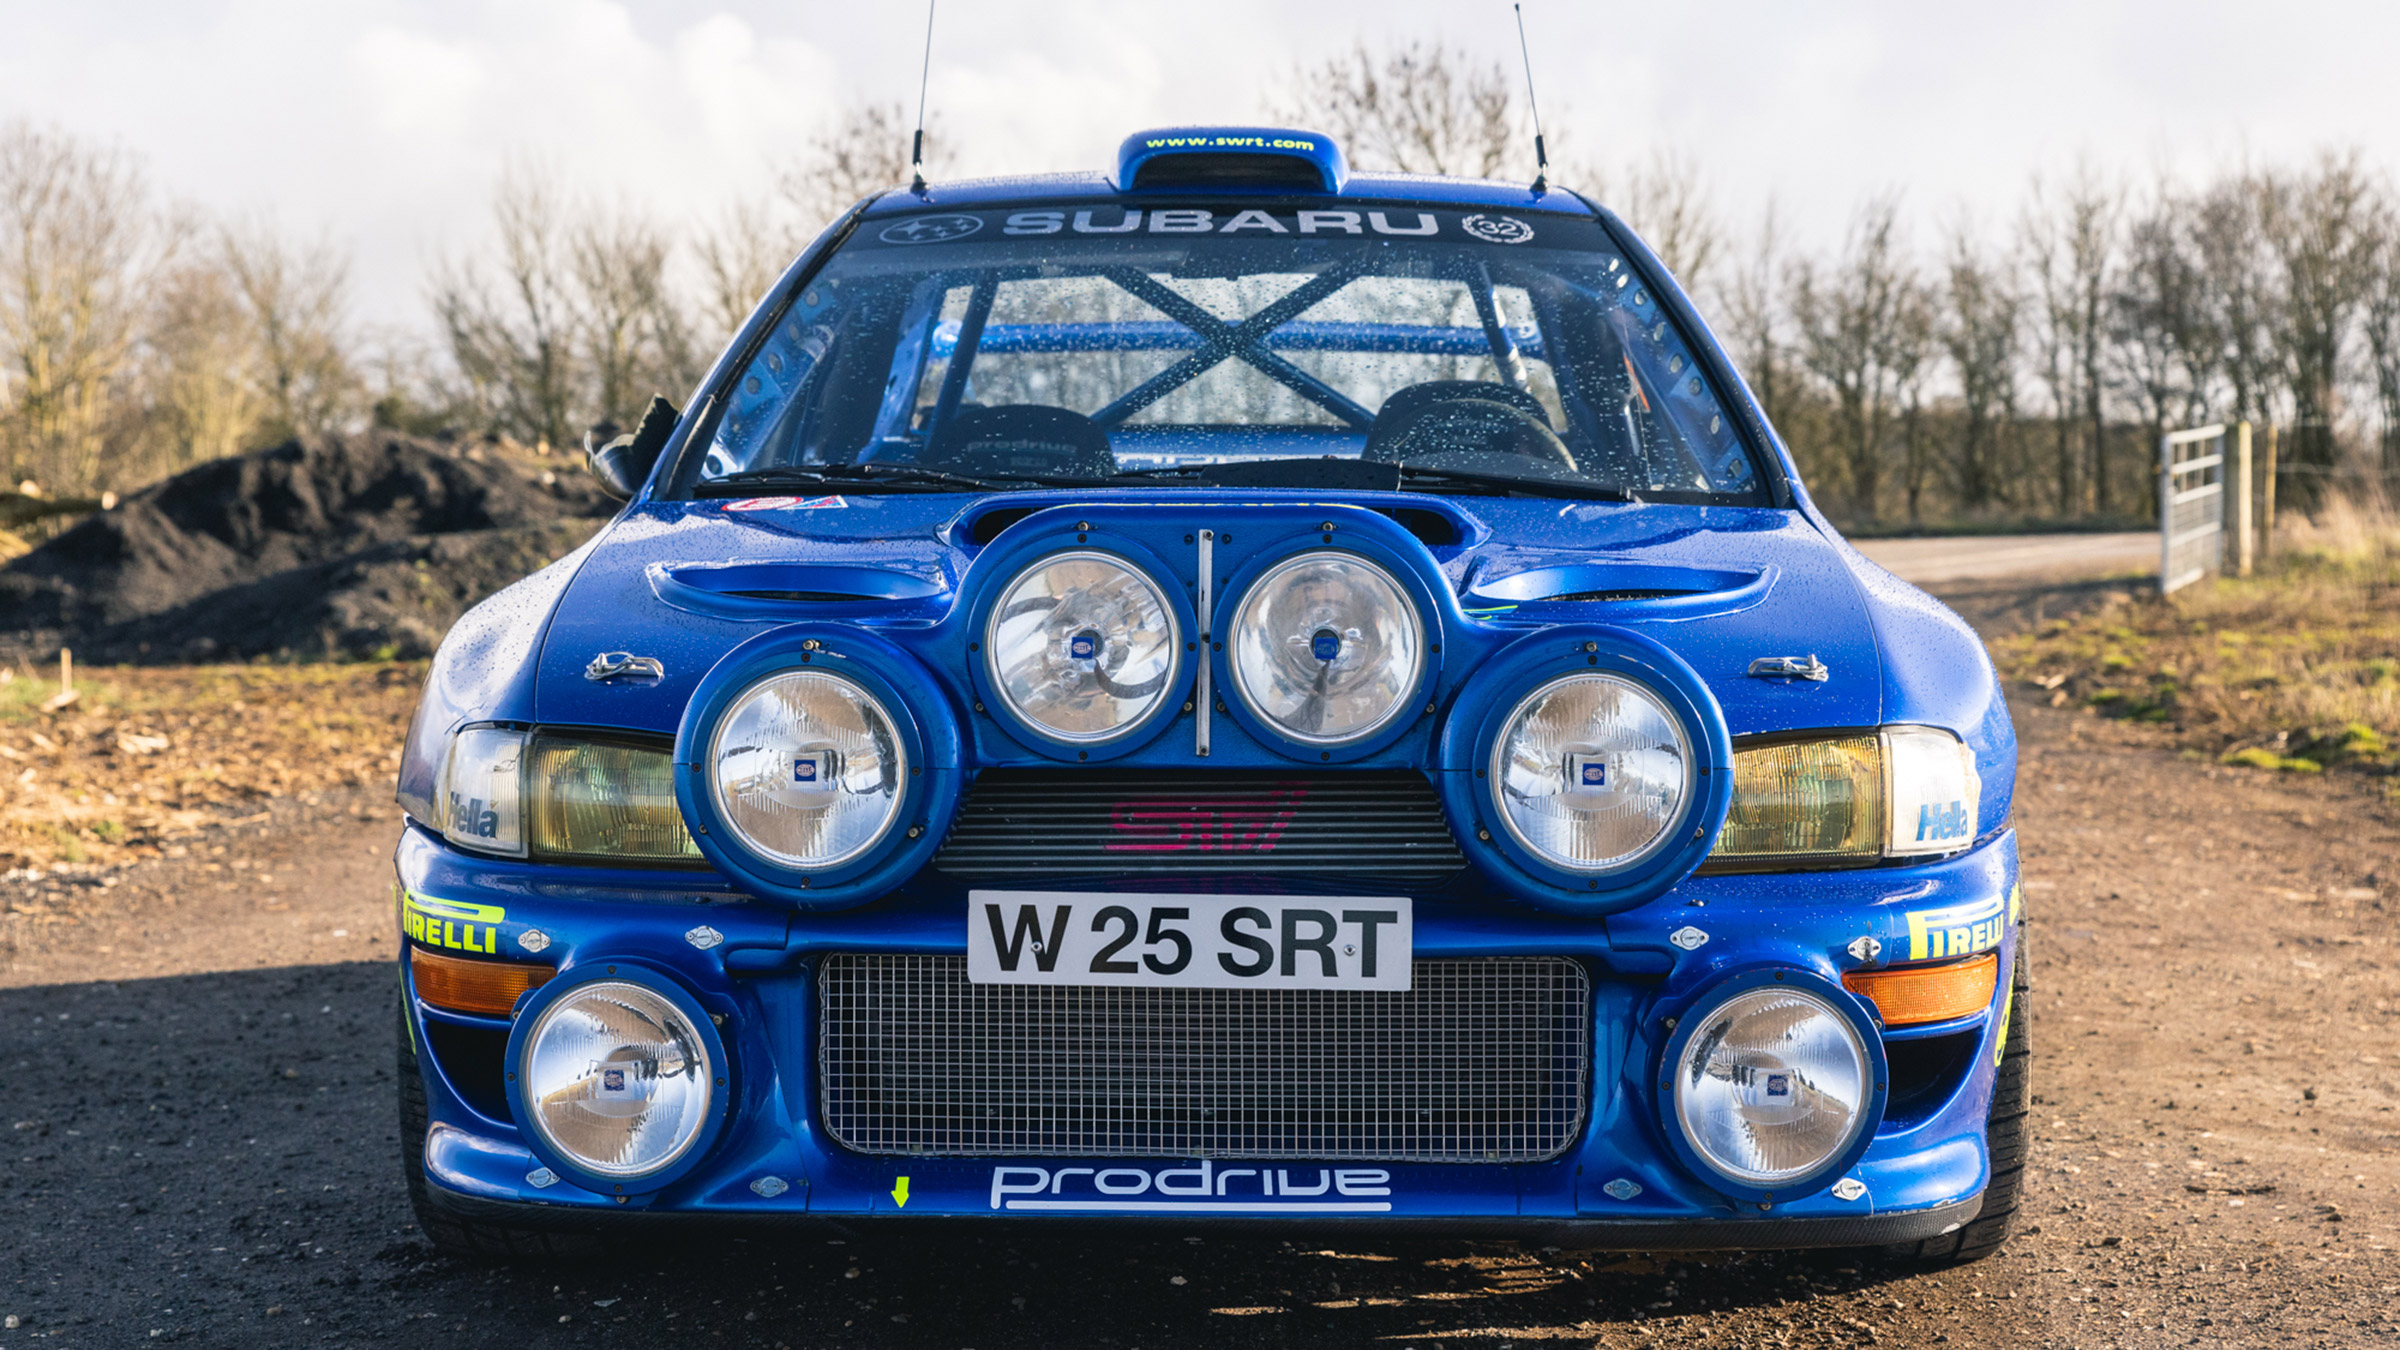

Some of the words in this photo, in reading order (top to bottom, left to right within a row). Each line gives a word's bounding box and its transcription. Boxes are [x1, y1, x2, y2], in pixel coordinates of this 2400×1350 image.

[1146, 137, 1315, 152] www.swrt.com
[1003, 210, 1439, 236] SUBARU
[1478, 220, 1519, 236] 32
[448, 791, 498, 838] Hella
[1916, 800, 1968, 841] Hella
[403, 886, 505, 955] PIRELLI
[984, 903, 1073, 972] W
[1089, 905, 1193, 976] 25
[1217, 906, 1399, 978] SRT
[990, 1160, 1392, 1211] prodrive
